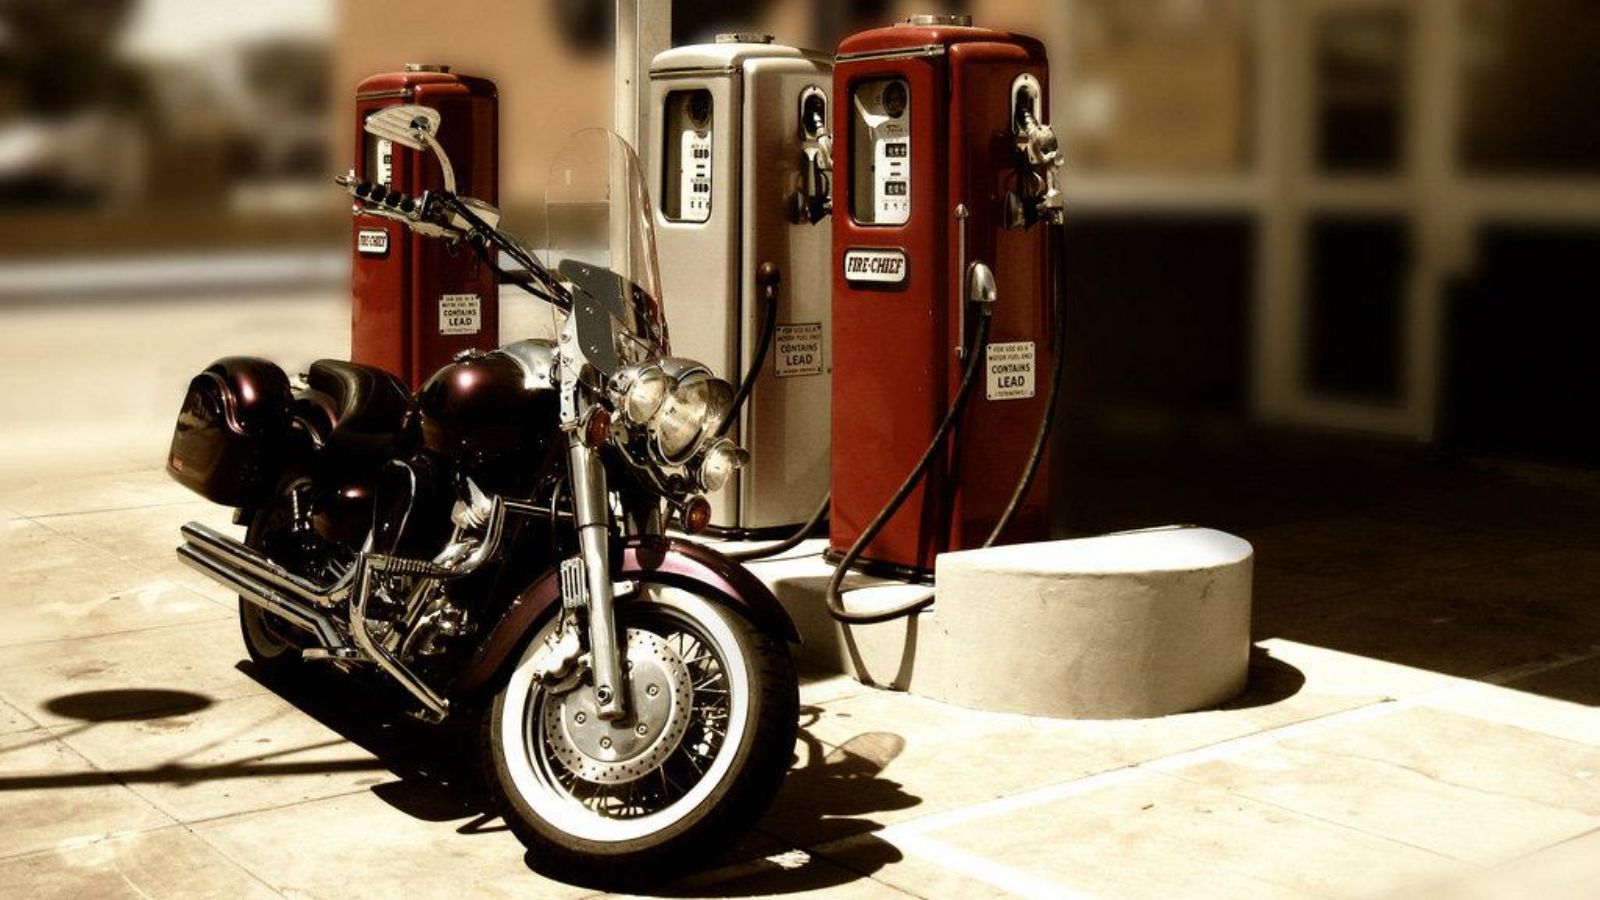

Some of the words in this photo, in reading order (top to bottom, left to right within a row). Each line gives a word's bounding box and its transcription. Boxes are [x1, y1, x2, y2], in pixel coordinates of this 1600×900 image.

[847, 256, 904, 274] FIRE-CHIEF
[443, 309, 477, 318] CONTAINS
[449, 317, 473, 327] LEAD
[780, 343, 818, 354] CONTAINS
[786, 354, 813, 366] LEAD
[991, 363, 1030, 374] CONTAINS
[997, 375, 1026, 388] LEAD
